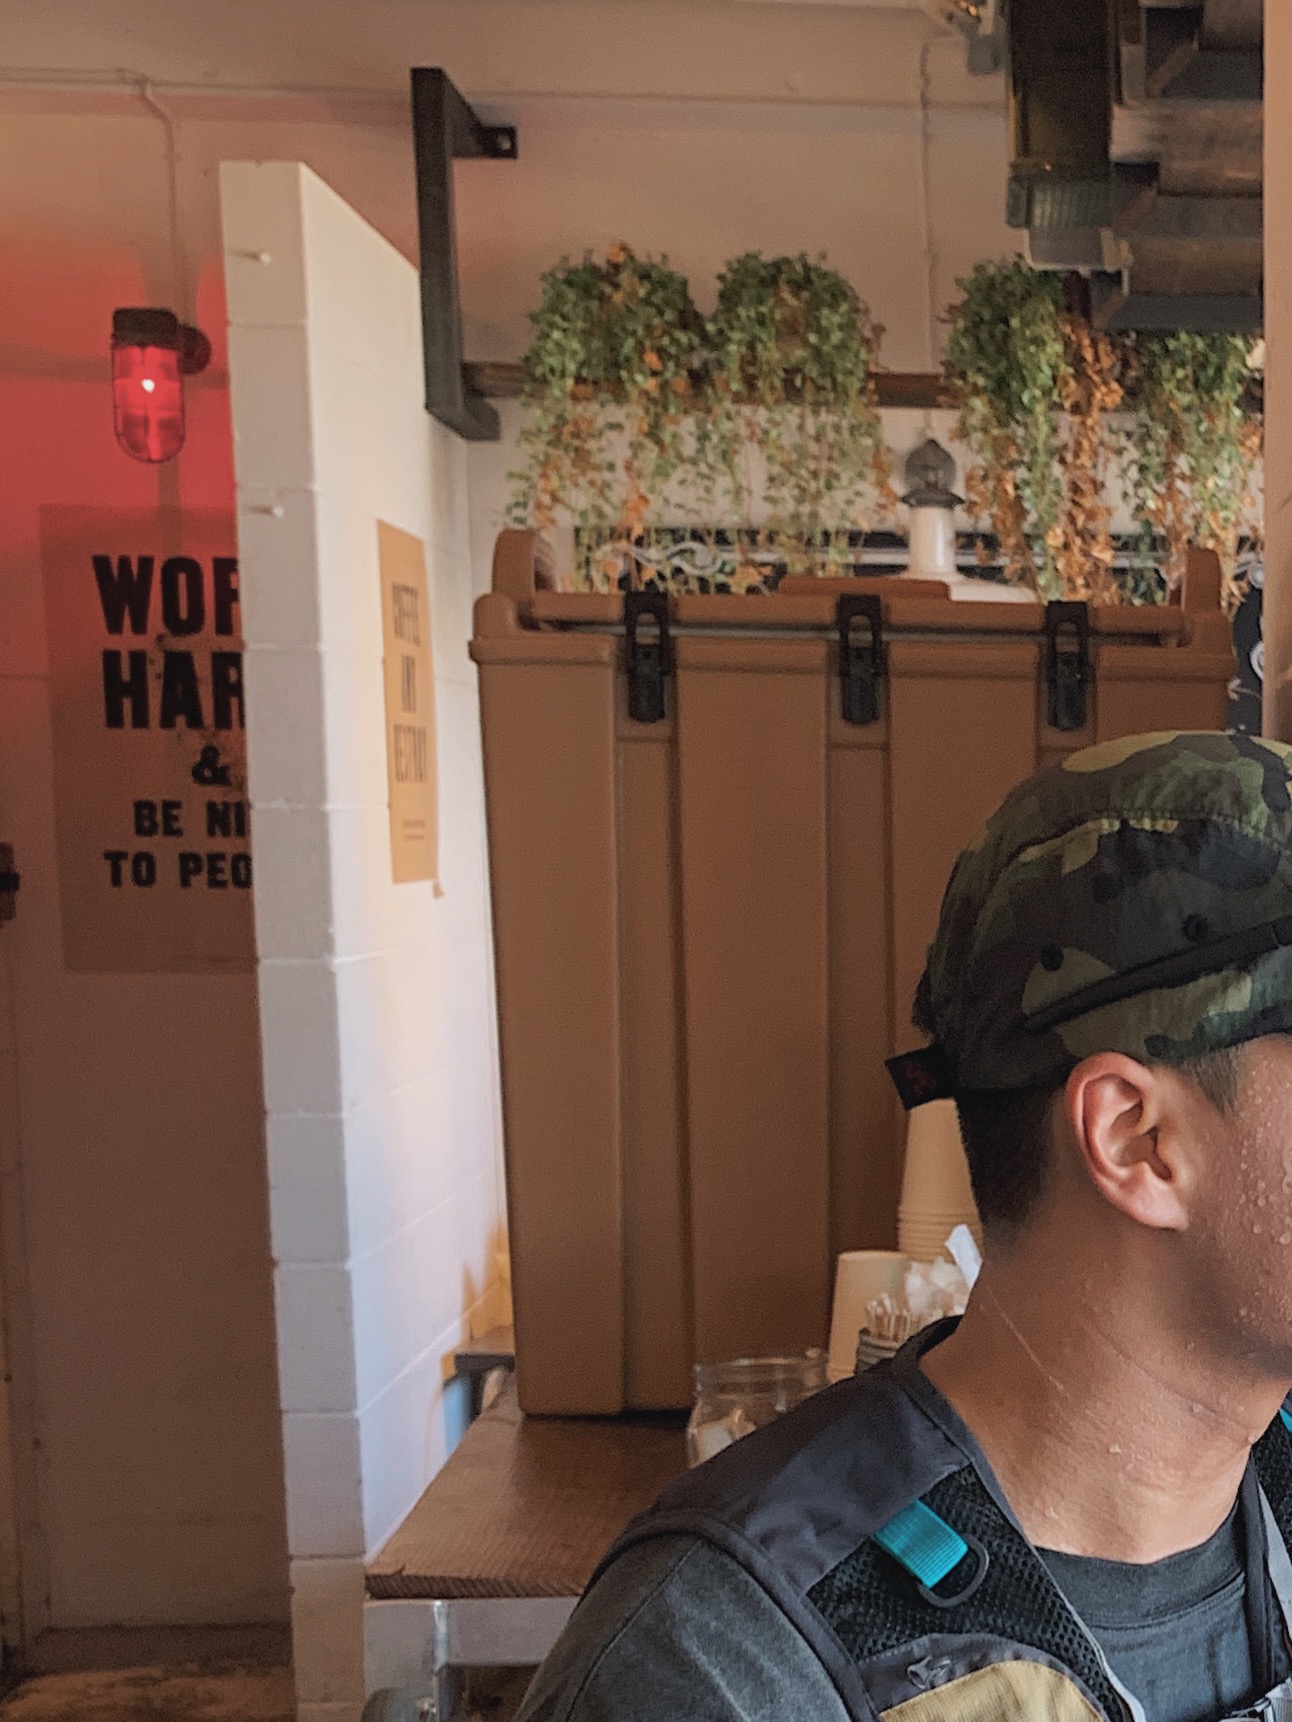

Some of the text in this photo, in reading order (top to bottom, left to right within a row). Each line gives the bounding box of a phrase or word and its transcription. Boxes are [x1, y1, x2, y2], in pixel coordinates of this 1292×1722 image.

[92, 554, 240, 636] WOR
[102, 650, 245, 729] HAR
[192, 744, 232, 786] &
[133, 800, 246, 838] BE NI
[103, 852, 252, 889] TO PEO
